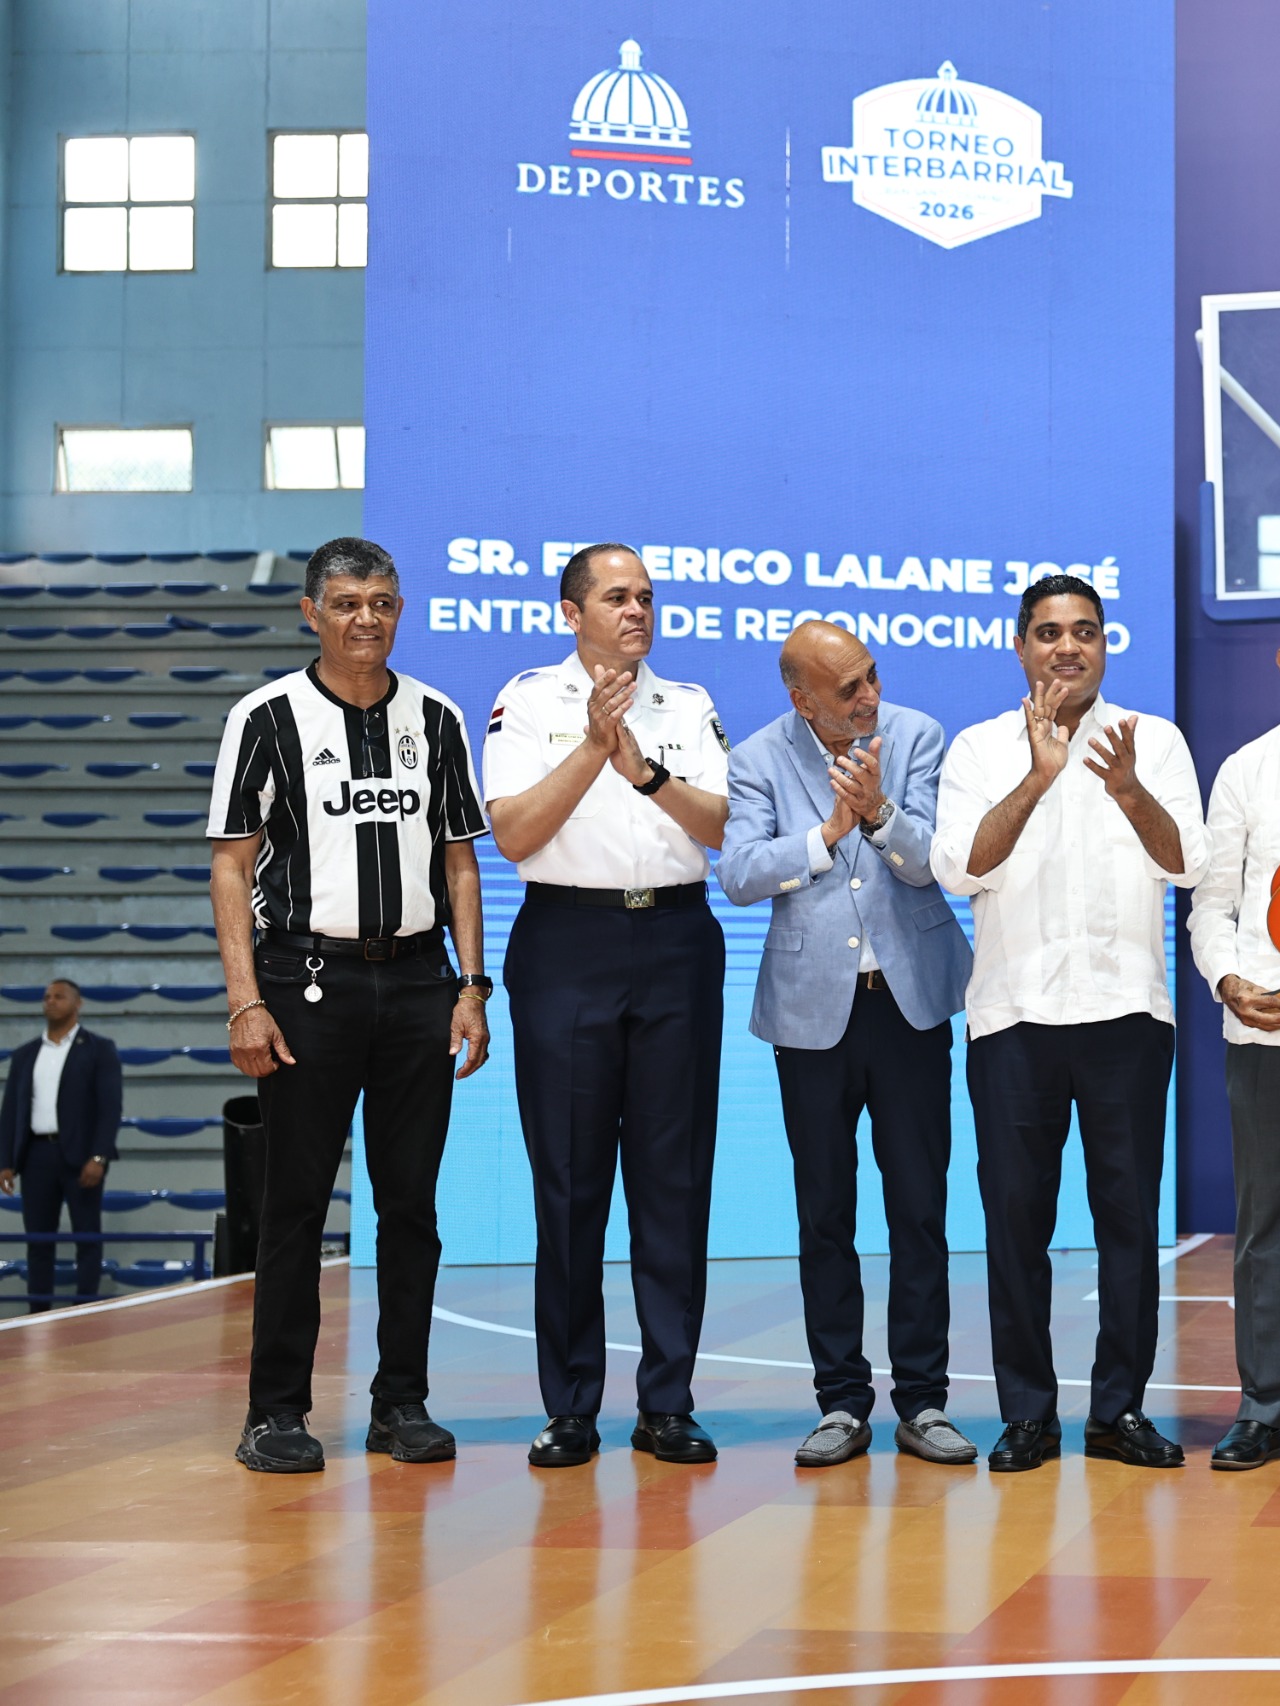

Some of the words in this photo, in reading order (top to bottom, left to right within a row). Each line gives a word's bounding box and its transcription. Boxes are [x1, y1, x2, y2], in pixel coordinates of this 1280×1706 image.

[884, 128, 1014, 157] TORNEO
[516, 161, 746, 209] DEPORTES
[828, 154, 1065, 191] INTERBARRIAL
[919, 201, 974, 220] 2026
[447, 537, 530, 577] SR.
[542, 540, 793, 586] FERICO
[805, 552, 994, 595] LALANE
[660, 604, 722, 640] DE
[312, 757, 341, 767] adidas
[322, 780, 421, 822] Jeep
